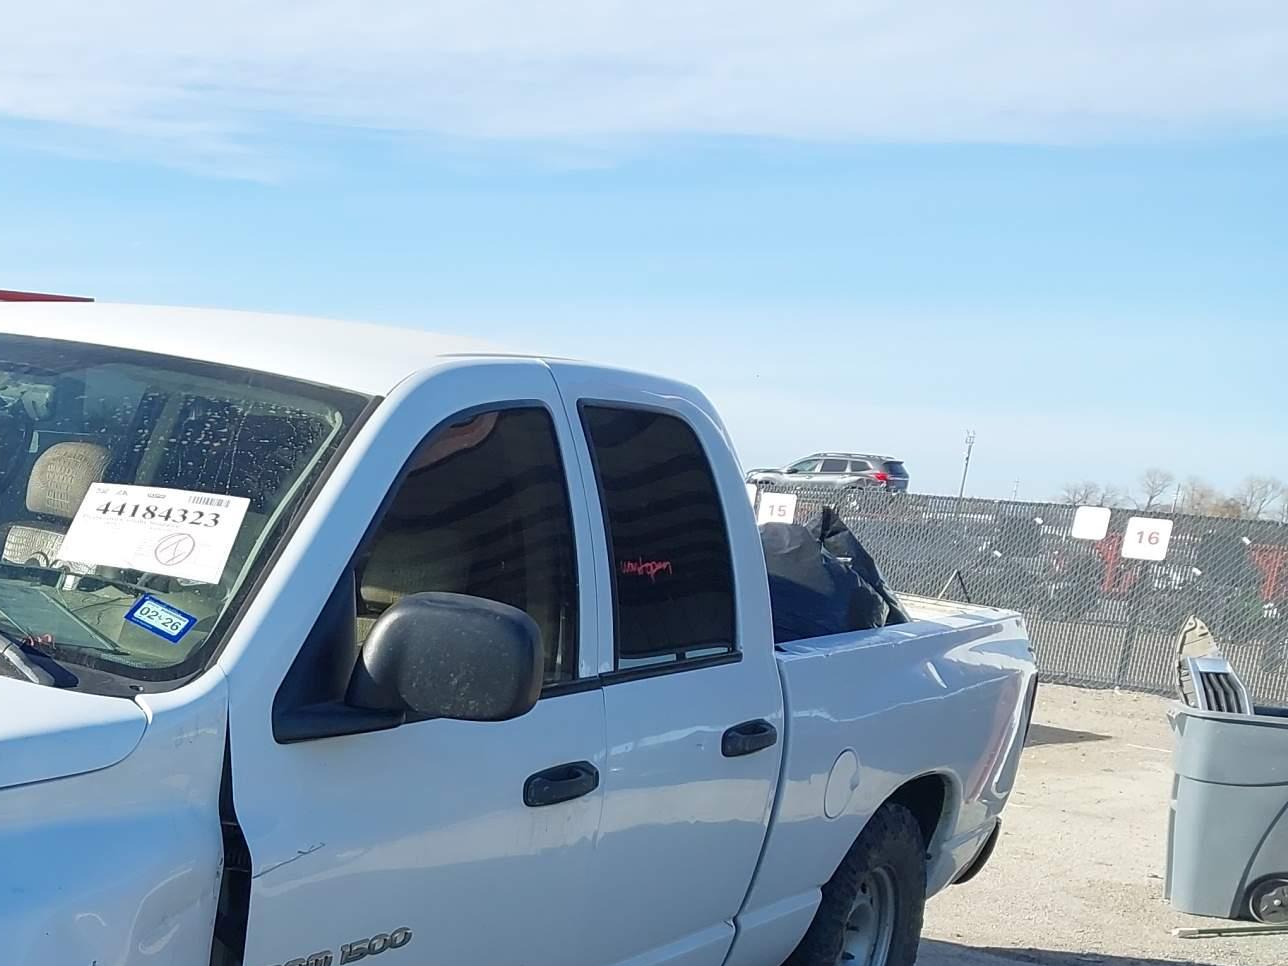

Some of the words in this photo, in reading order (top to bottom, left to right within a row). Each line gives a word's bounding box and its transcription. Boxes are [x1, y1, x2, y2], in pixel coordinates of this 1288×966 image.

[96, 500, 221, 528] 44184323
[768, 504, 787, 518] 15
[1137, 530, 1161, 545] 16
[139, 606, 159, 620] 02
[161, 617, 182, 631] 26
[339, 926, 414, 966] 1500
